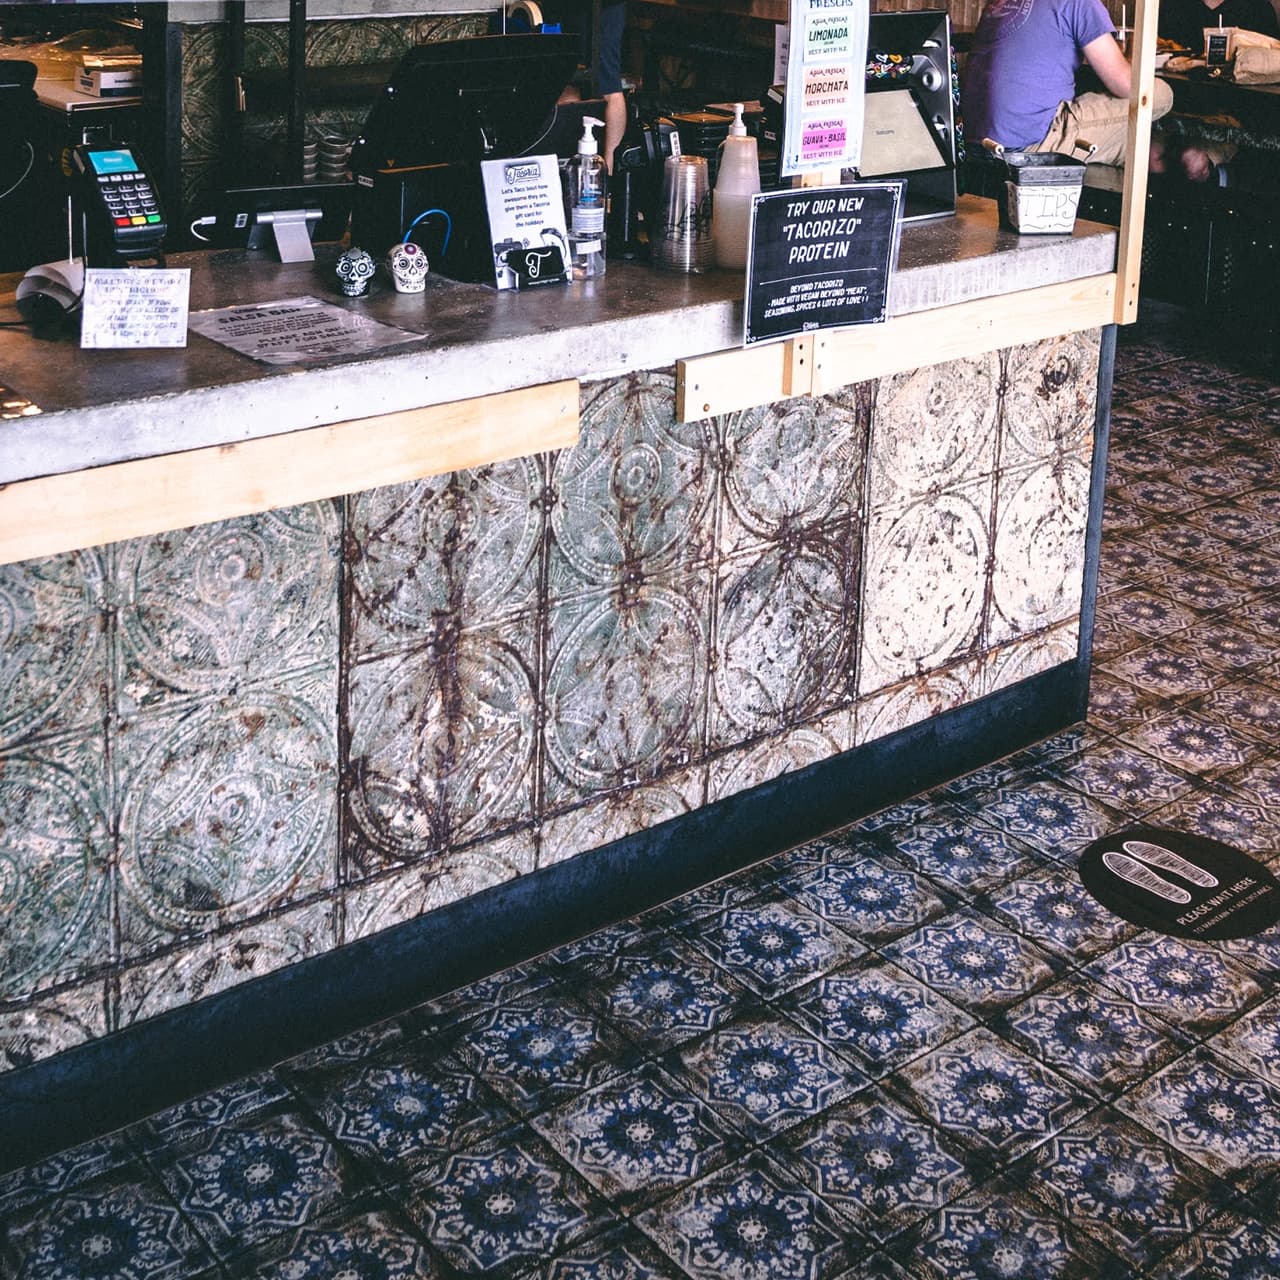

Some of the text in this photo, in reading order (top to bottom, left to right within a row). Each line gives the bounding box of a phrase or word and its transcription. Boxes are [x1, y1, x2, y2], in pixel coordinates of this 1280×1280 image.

[808, 26, 849, 42] LIMONADA
[802, 131, 847, 147] GUAVA BASIL
[786, 196, 865, 218] TRY OUR NEW
[1017, 190, 1079, 220] TIPS
[782, 218, 862, 242] "TACORIZO"
[788, 240, 851, 265] PROTEIN
[1176, 876, 1257, 927] PLEASE WAIT HERE
